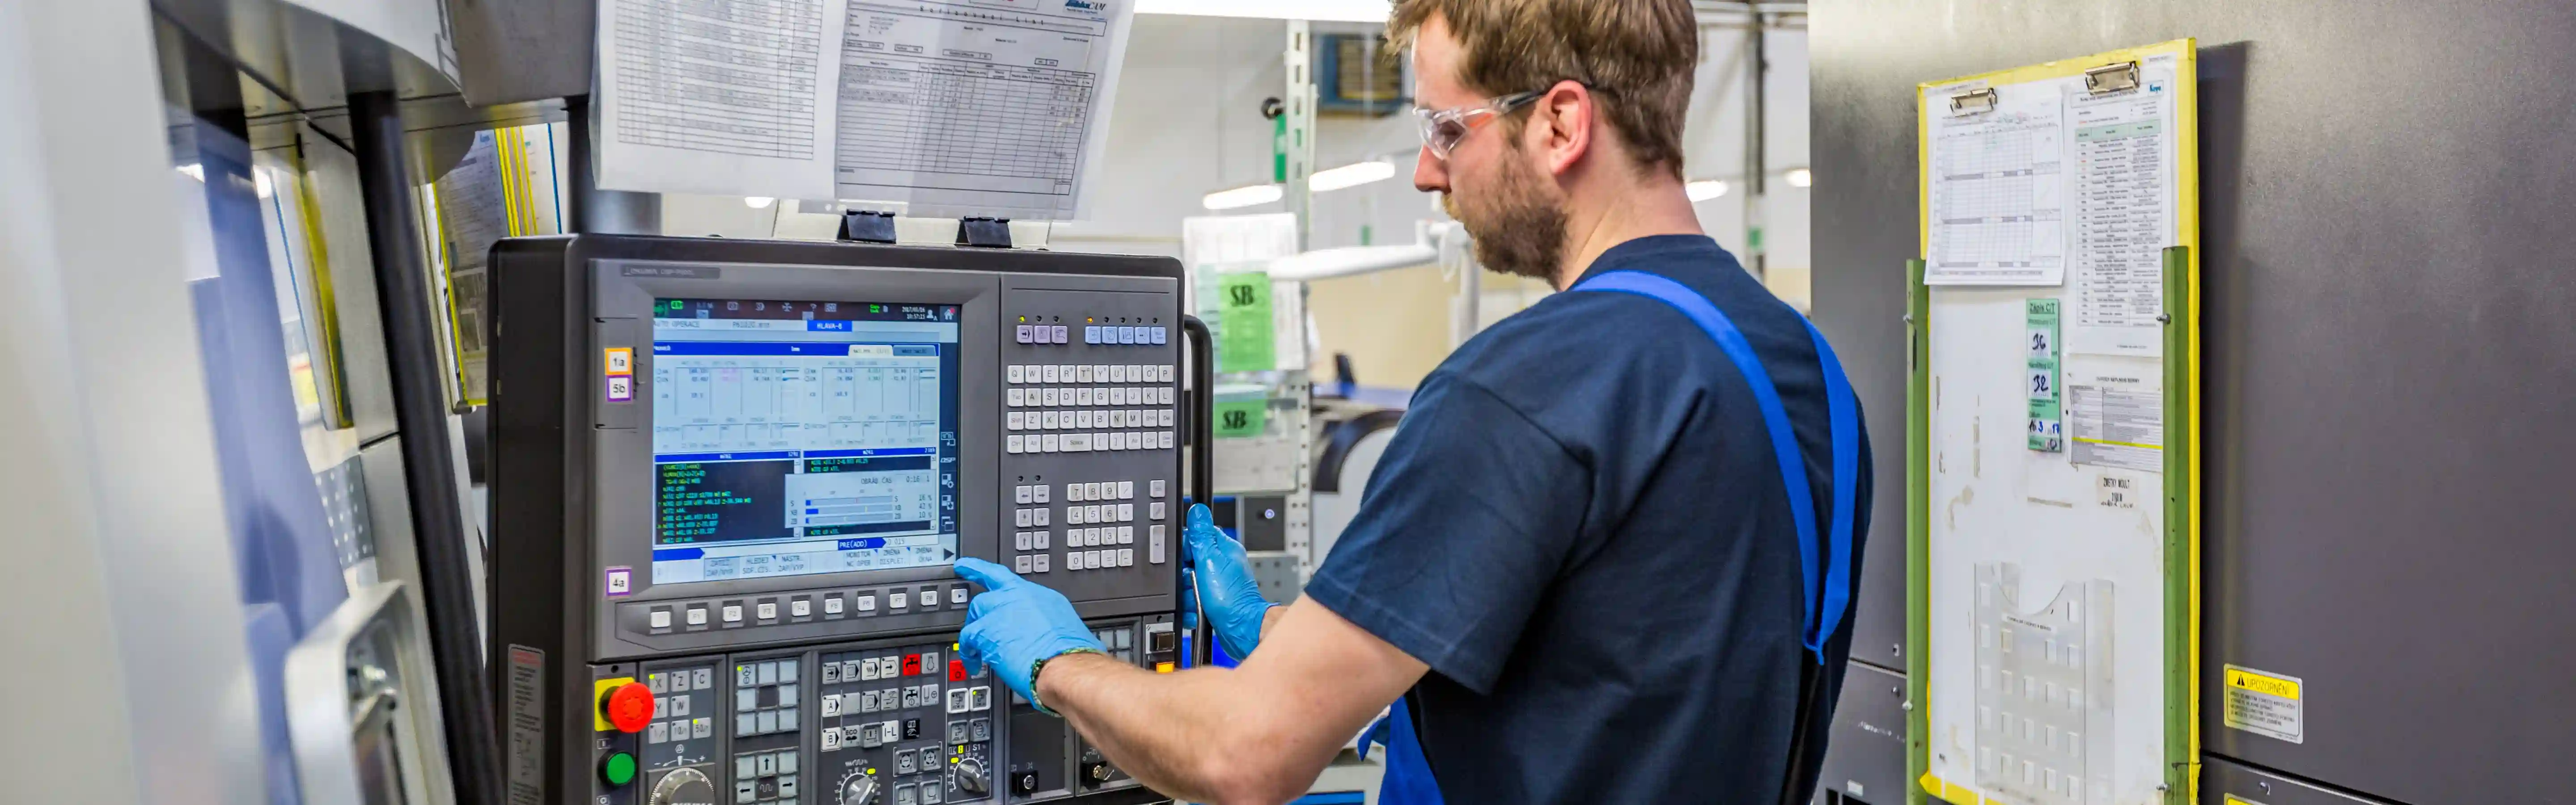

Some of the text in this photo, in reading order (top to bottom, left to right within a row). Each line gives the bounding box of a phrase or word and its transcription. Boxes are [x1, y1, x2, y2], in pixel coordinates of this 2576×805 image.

[613, 357, 625, 367] 1a
[613, 384, 625, 393] 5b
[2034, 374, 2049, 393] 32
[613, 578, 624, 587] 4a
[655, 678, 662, 688] X
[678, 676, 684, 686] Z
[699, 674, 705, 684] C
[655, 703, 661, 713] Y
[676, 700, 685, 710] W
